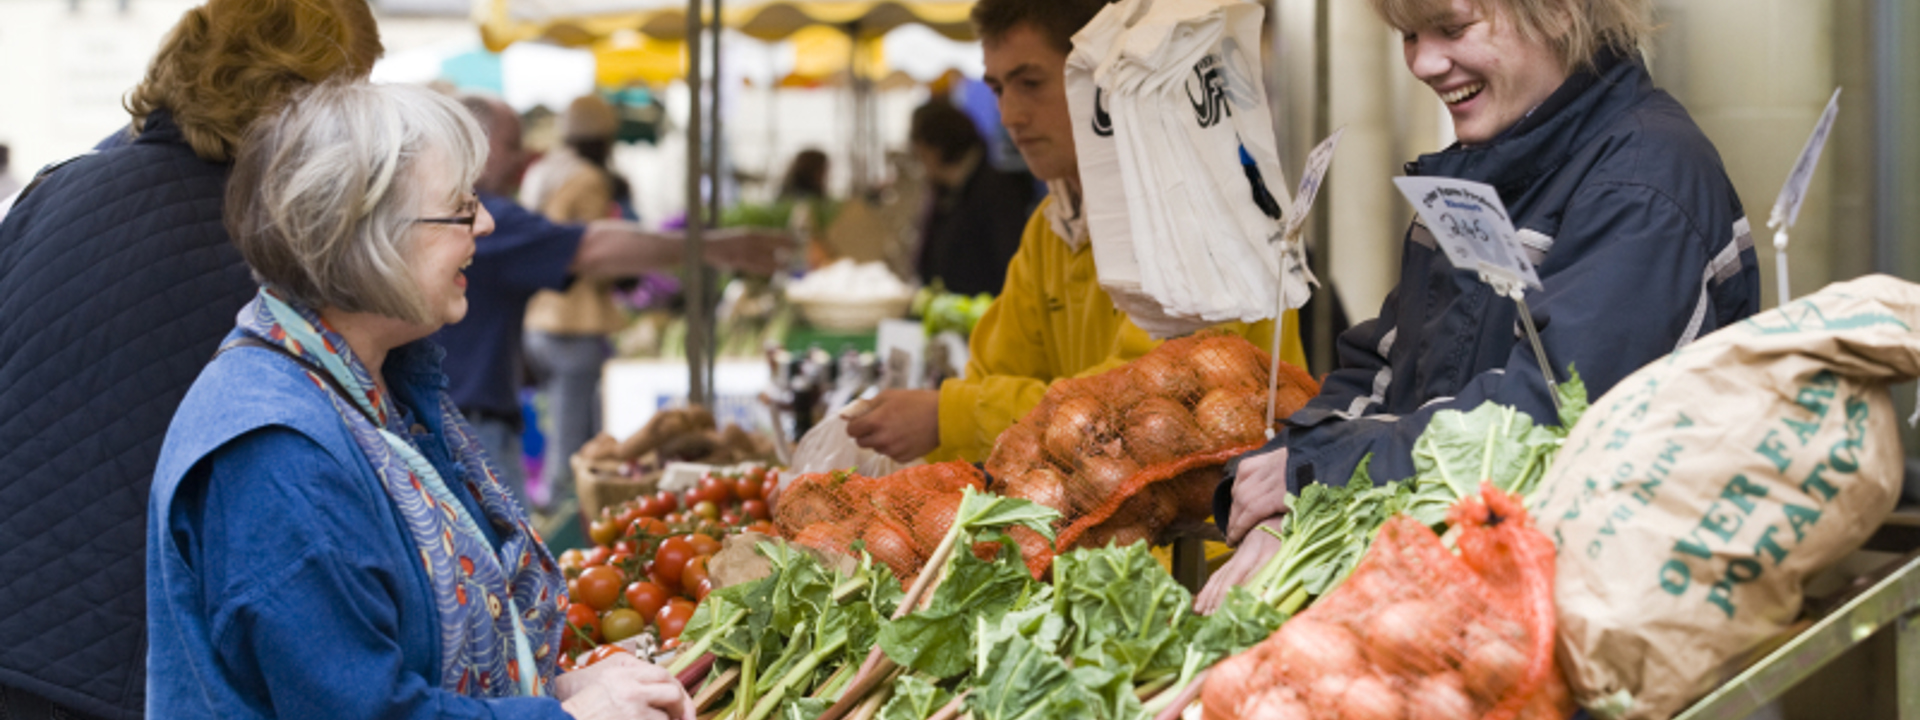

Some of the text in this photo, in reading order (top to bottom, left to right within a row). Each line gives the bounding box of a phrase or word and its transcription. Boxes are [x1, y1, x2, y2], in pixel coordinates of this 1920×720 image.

[1674, 411, 1695, 429] A
[1632, 438, 1684, 506] MINI
[1586, 502, 1635, 562] BAG
[1659, 473, 1769, 597] OVER
